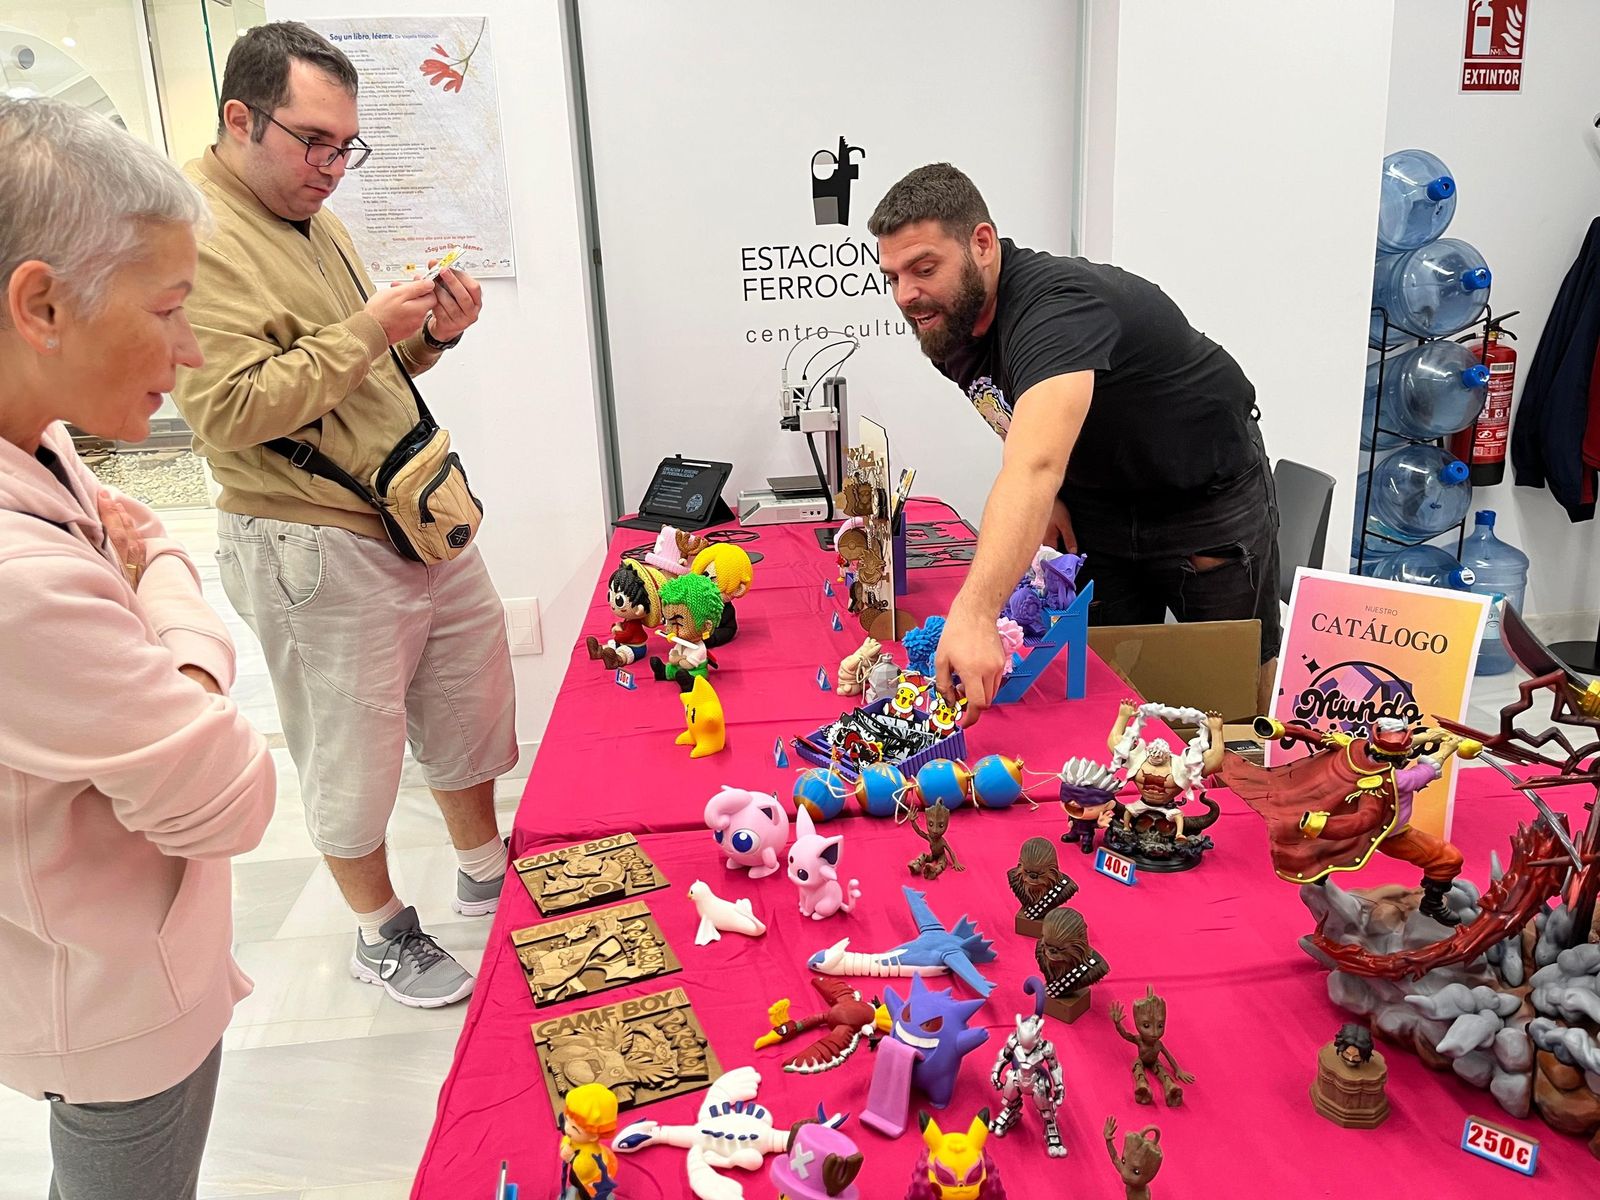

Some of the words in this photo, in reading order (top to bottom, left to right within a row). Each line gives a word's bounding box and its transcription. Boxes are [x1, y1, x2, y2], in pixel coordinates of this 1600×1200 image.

[329, 33, 343, 42] Soy
[353, 32, 371, 41] libro,
[372, 32, 394, 40] léeme.
[1463, 69, 1520, 85] EXTINTOR
[741, 237, 880, 271] ESTACIÓN
[746, 323, 829, 343] centro
[844, 319, 915, 338] cultu
[1364, 604, 1398, 617] NUESTRO
[1311, 612, 1448, 654] CATÁLOGO
[1295, 688, 1424, 724] Mundo
[584, 835, 623, 853] BOY
[1104, 854, 1128, 878] 40€
[622, 991, 673, 1018] BOY
[1467, 1124, 1530, 1165] 250€
